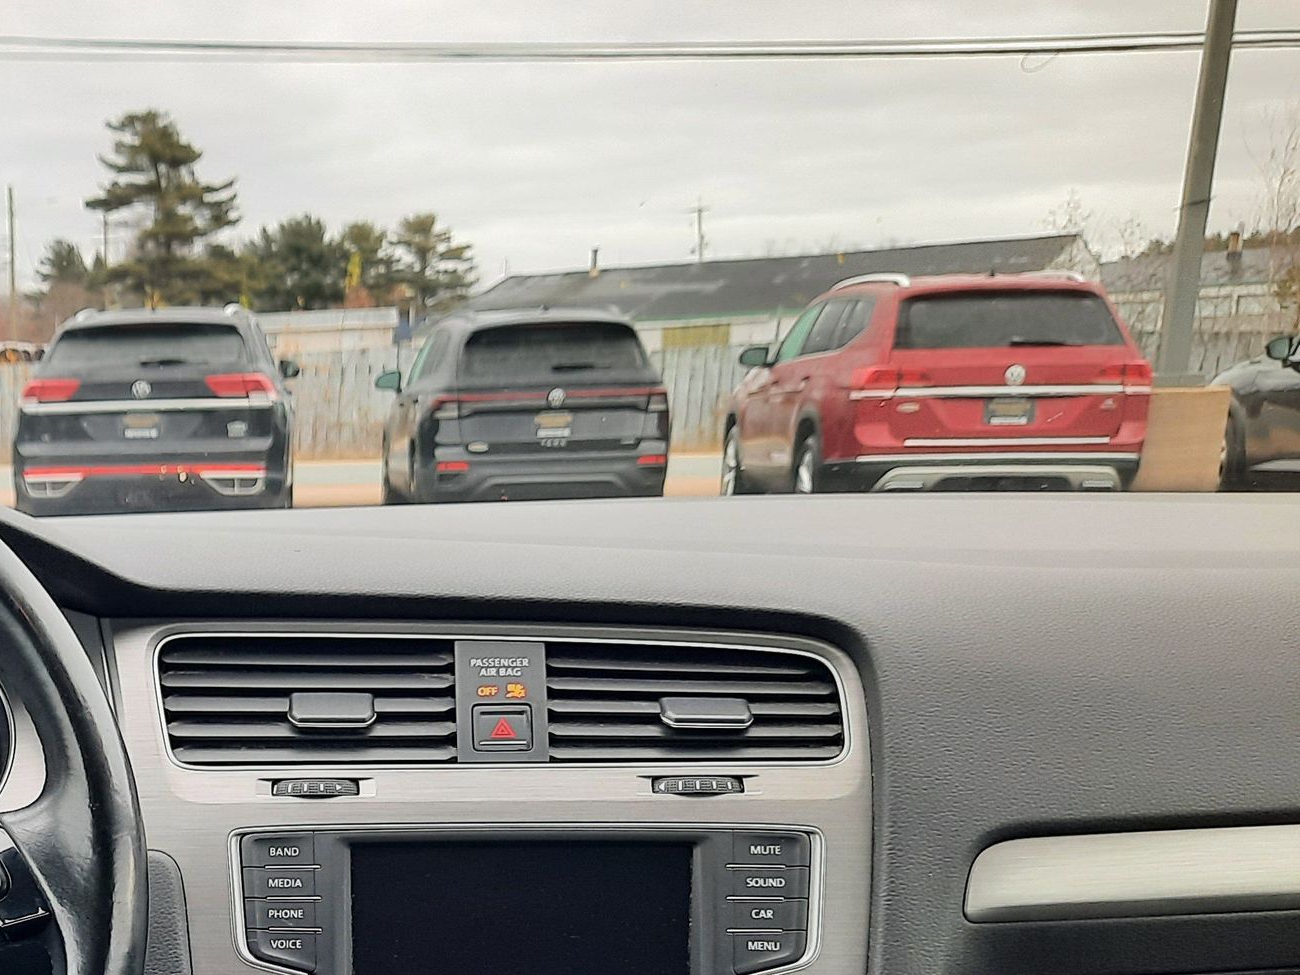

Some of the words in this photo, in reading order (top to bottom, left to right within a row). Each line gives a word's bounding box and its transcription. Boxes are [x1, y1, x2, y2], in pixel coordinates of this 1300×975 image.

[469, 657, 530, 668] PASSENGER
[479, 667, 497, 677] AIR
[498, 667, 522, 677] BAG
[477, 686, 499, 697] OFF
[269, 847, 300, 857] BAND
[750, 845, 781, 855] MUTE
[268, 878, 302, 888] MEDIA
[745, 877, 786, 888] SOUND
[268, 909, 304, 919] PHONE
[751, 909, 774, 919] CAR
[270, 939, 303, 949] VOICE
[747, 941, 781, 951] MENU
